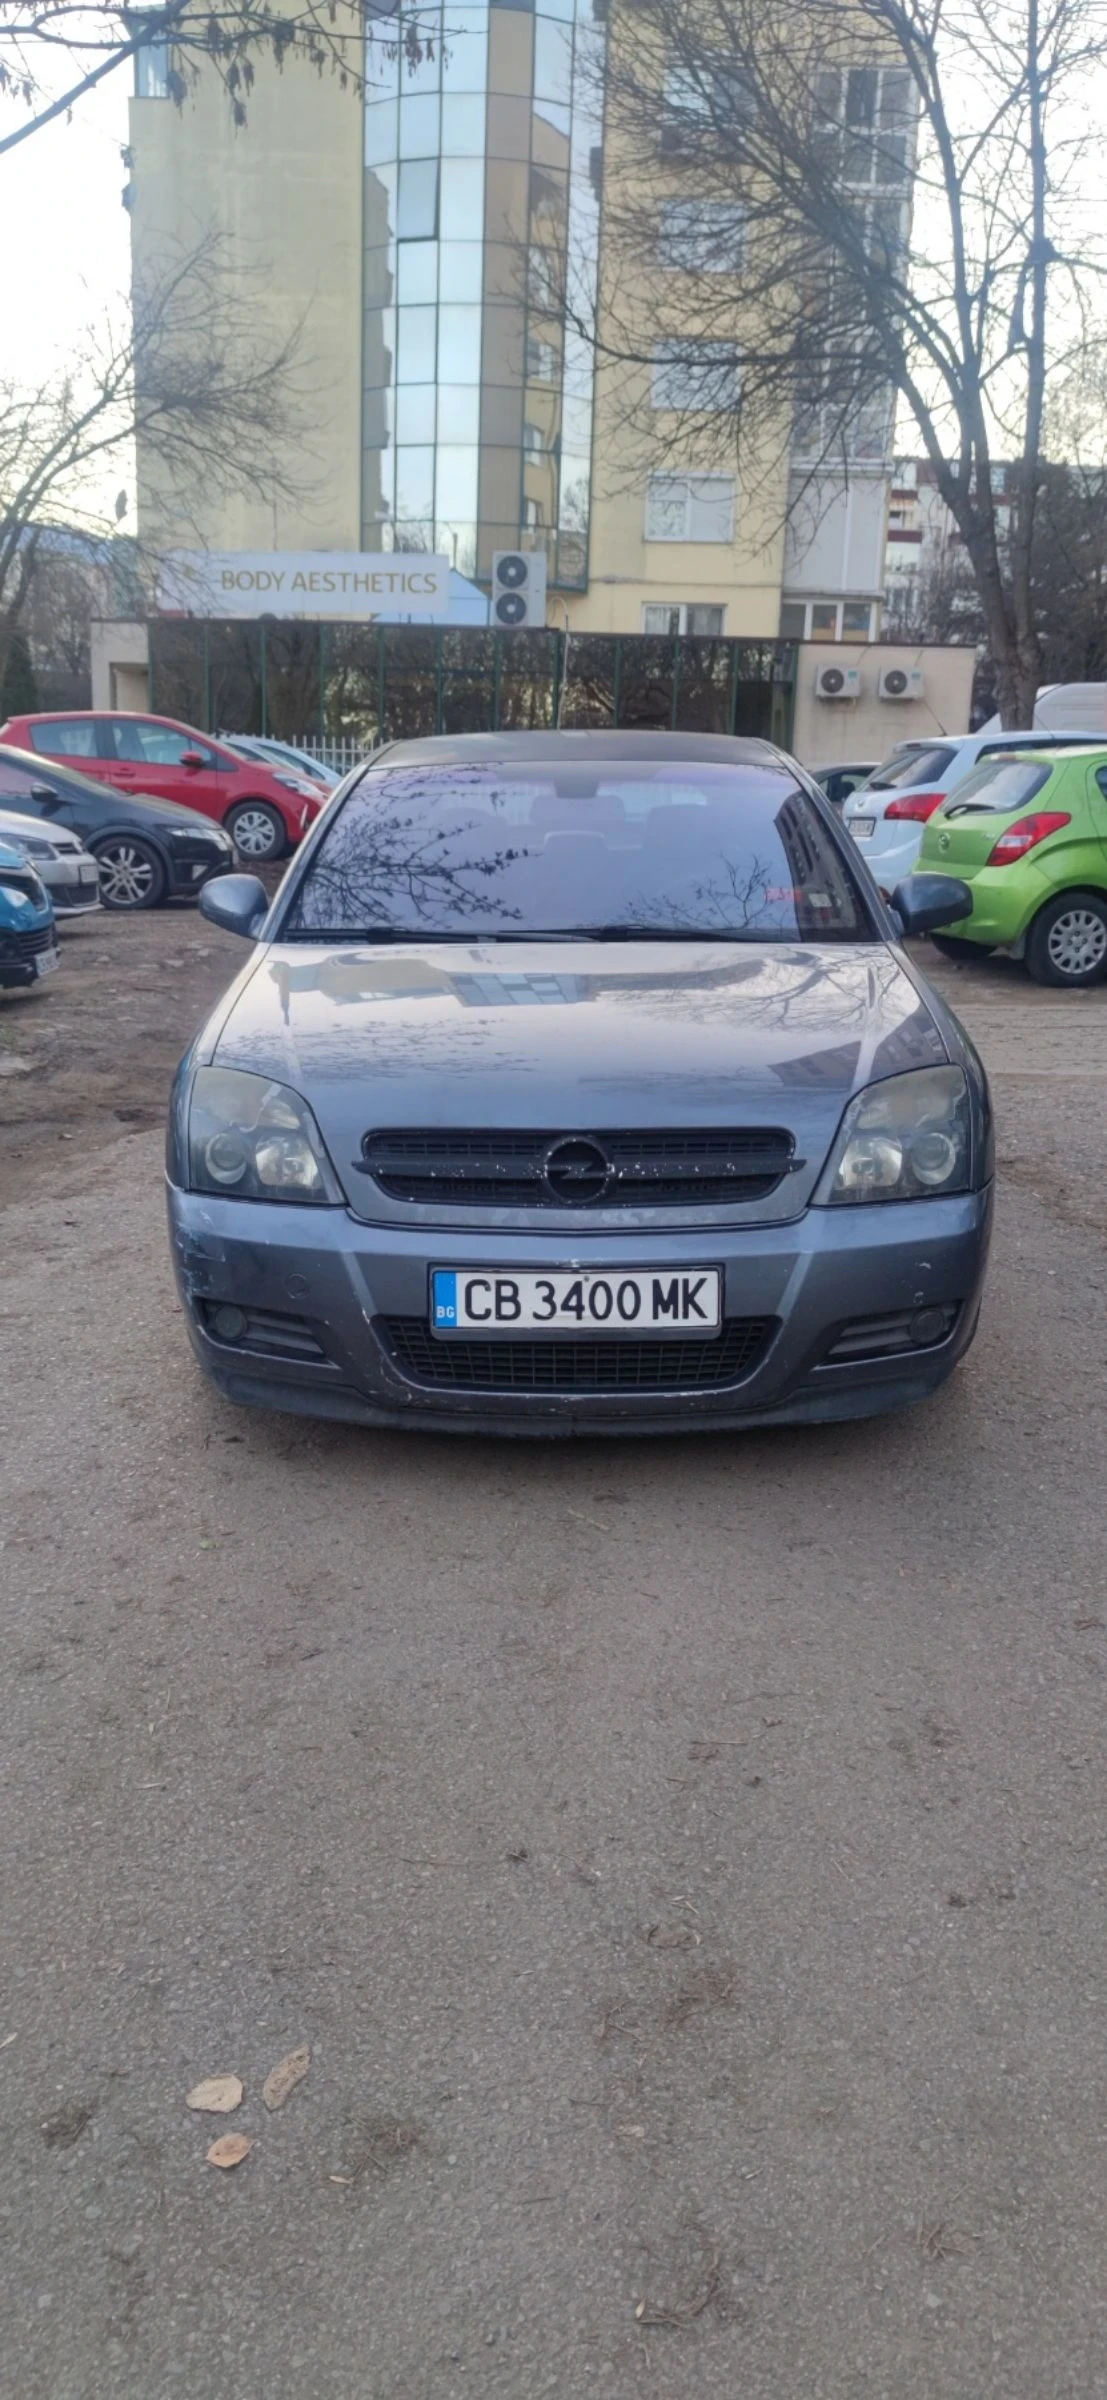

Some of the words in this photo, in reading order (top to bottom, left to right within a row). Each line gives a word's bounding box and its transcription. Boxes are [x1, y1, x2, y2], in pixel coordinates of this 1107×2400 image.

[221, 570, 286, 591] BODY
[291, 571, 438, 593] AESTHETICS
[464, 1279, 521, 1321] CB
[532, 1280, 642, 1321] 3400
[652, 1278, 708, 1320] MK
[436, 1305, 455, 1318] BG
